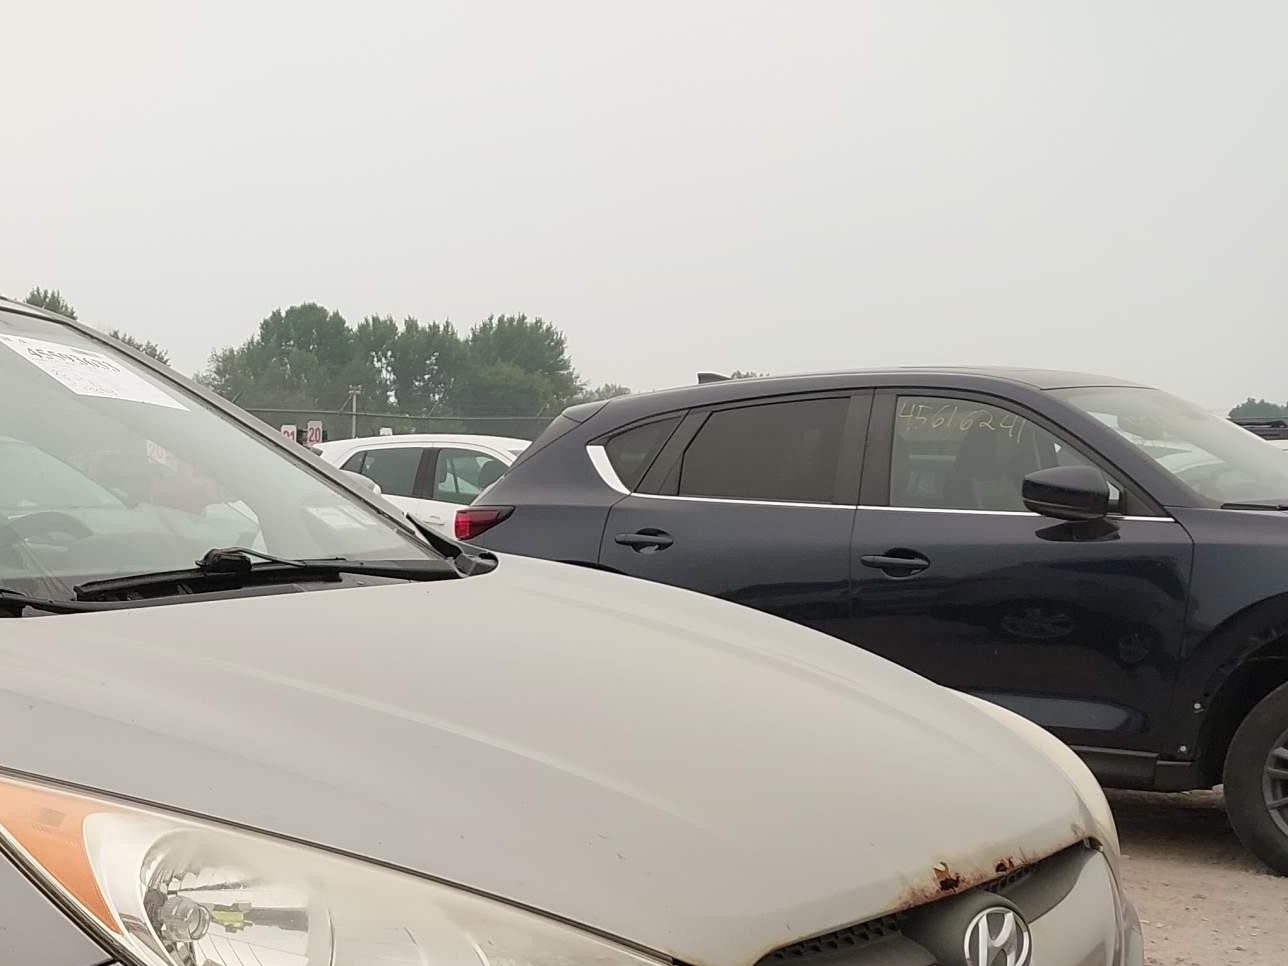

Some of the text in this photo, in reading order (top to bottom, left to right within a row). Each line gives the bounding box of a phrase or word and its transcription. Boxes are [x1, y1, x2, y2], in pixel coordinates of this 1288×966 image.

[25, 347, 122, 374] 45593633
[308, 427, 321, 442] 20
[898, 402, 1029, 444] 45616241
